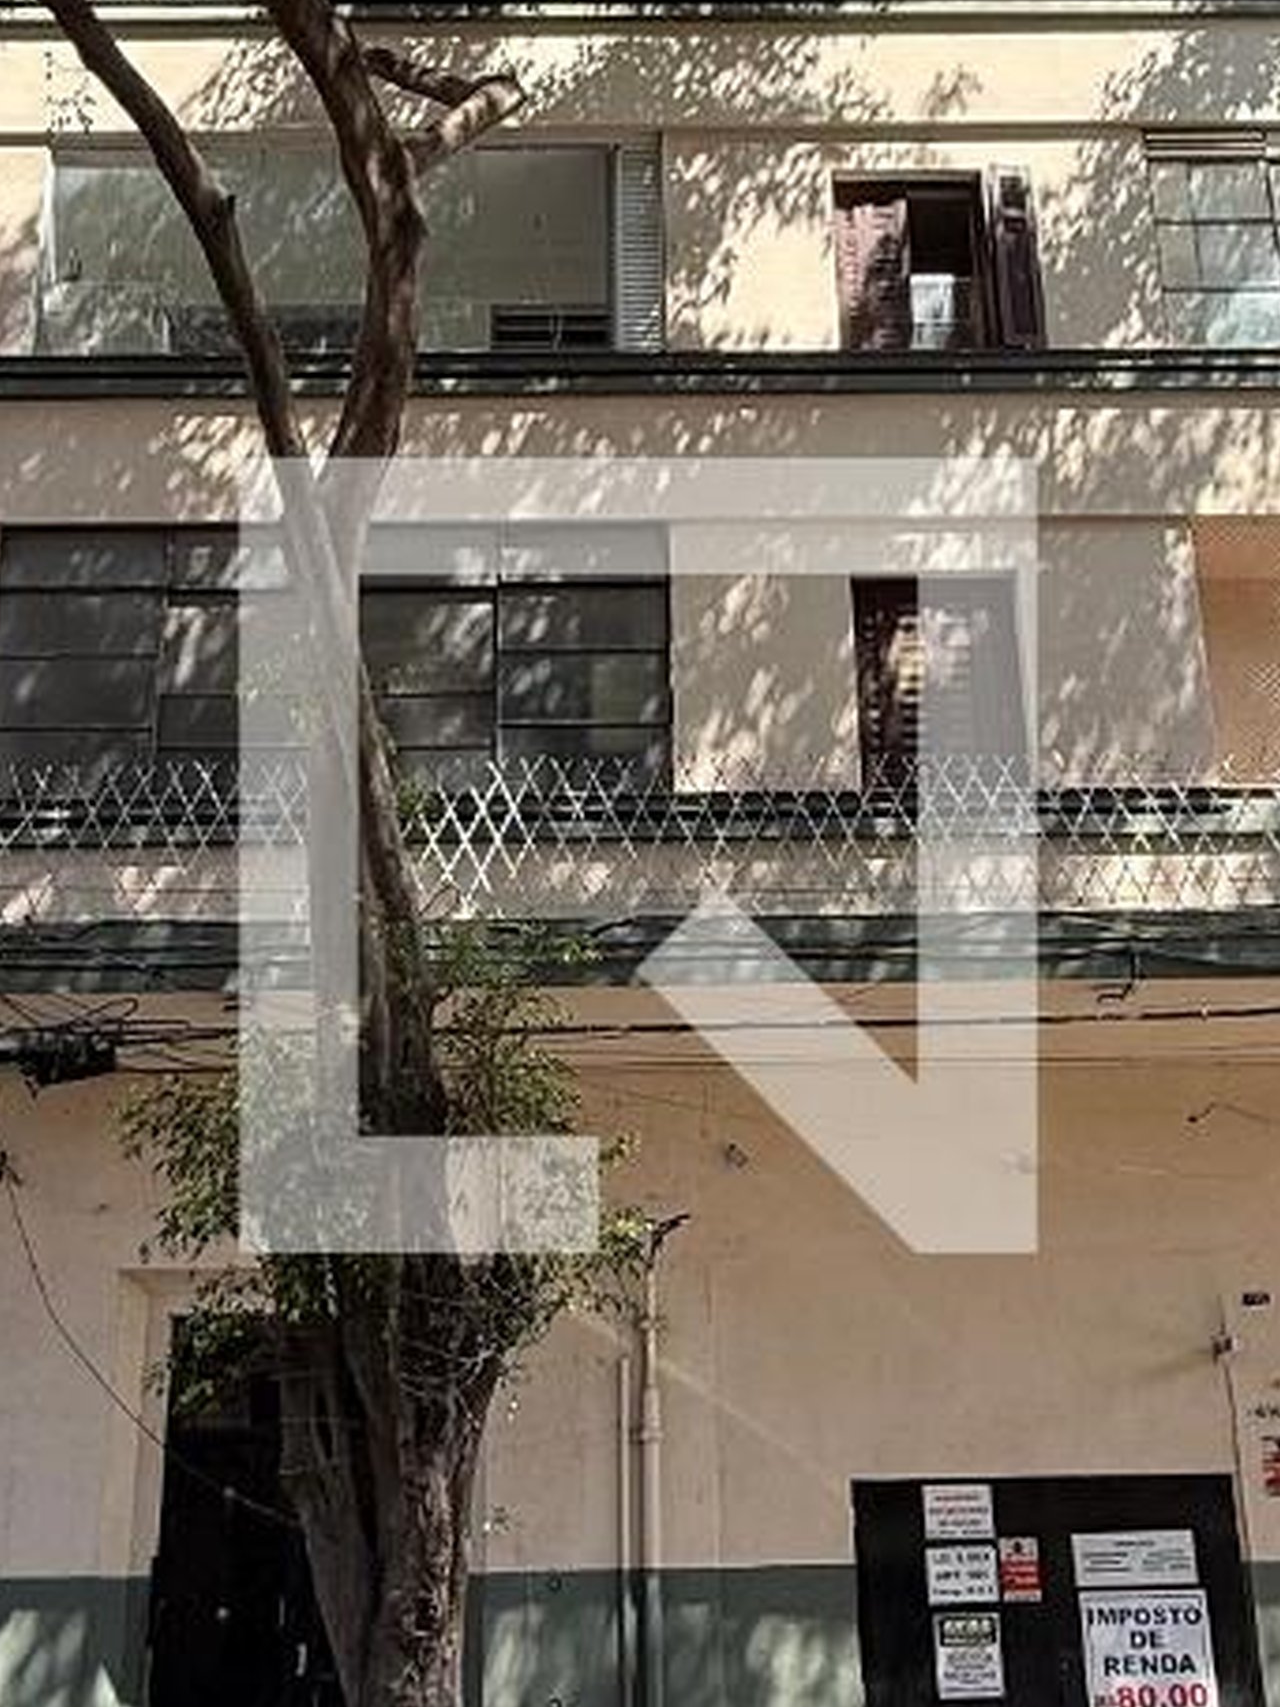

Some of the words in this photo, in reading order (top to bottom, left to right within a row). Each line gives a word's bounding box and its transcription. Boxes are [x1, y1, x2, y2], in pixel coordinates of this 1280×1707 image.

[1087, 1607, 1203, 1626] IMPOSTO
[1130, 1630, 1166, 1649] DE
[1104, 1654, 1197, 1676] RENDA
